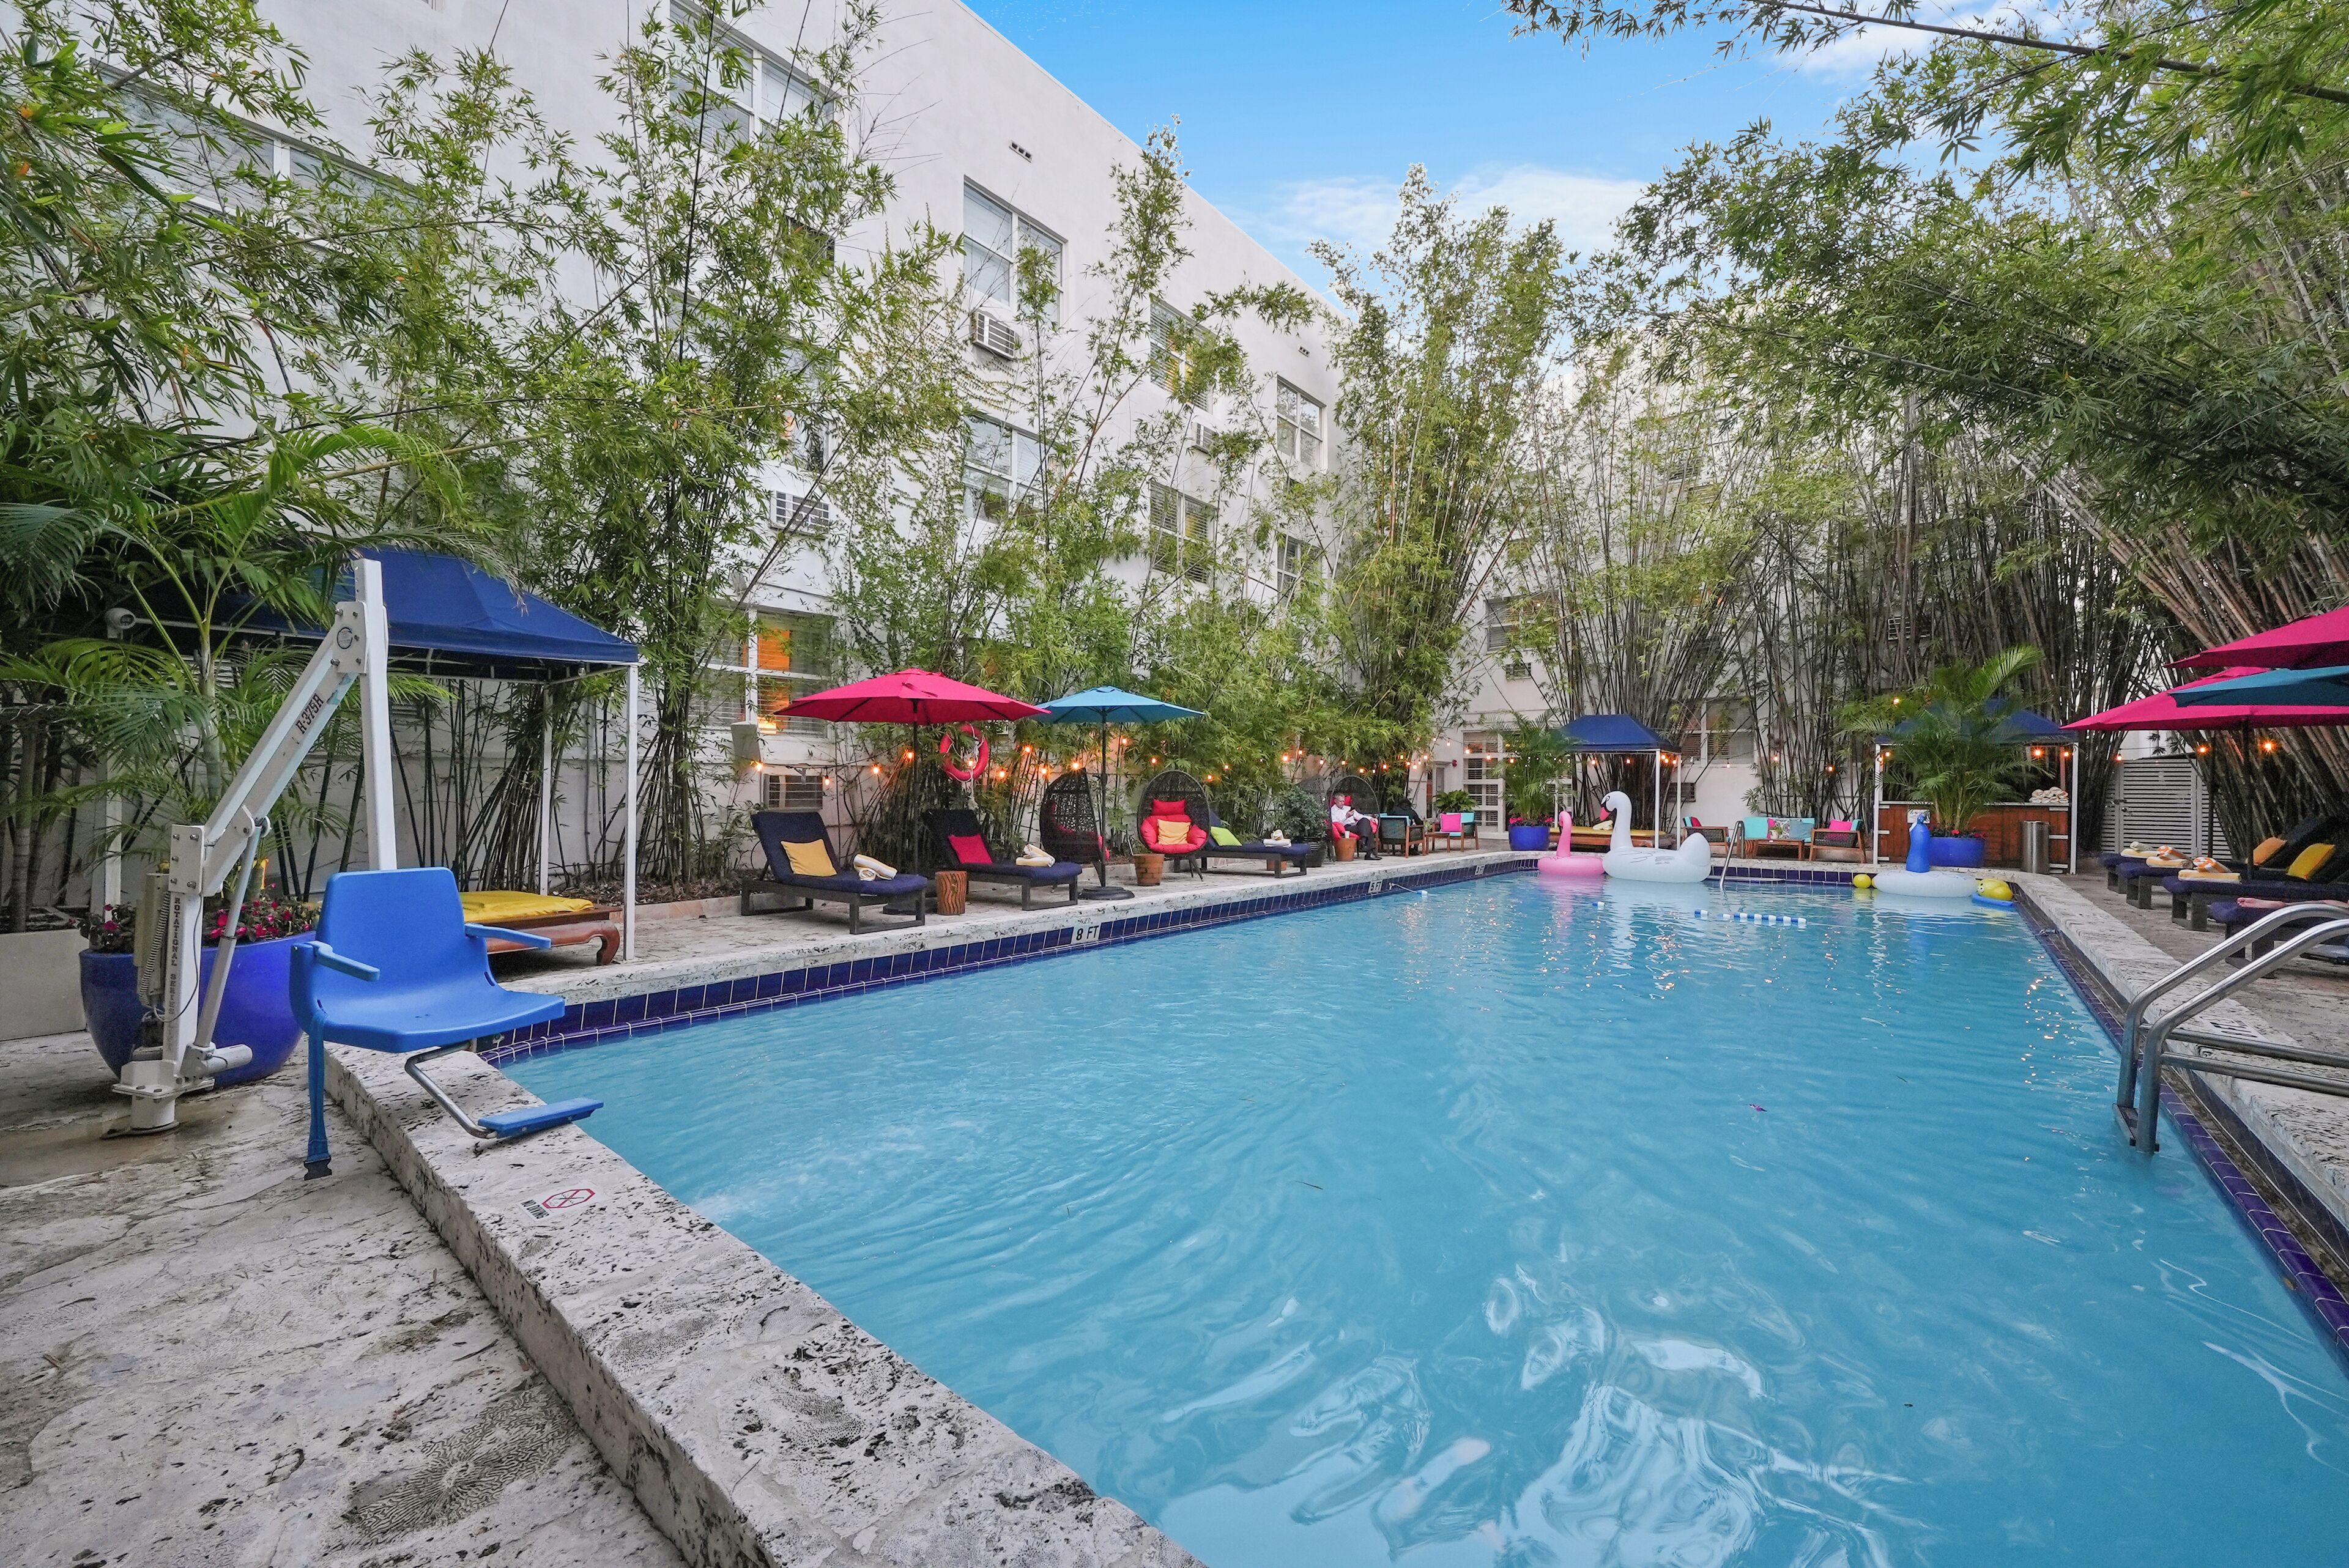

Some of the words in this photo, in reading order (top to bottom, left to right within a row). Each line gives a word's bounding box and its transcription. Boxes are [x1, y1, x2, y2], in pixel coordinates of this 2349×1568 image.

[1370, 882, 1375, 891] 5
[1375, 881, 1382, 890] FT
[171, 897, 180, 966] ROTATIONAL
[1076, 928, 1083, 941] 8
[1086, 925, 1099, 939] FT
[526, 1205, 550, 1219] DIVING
